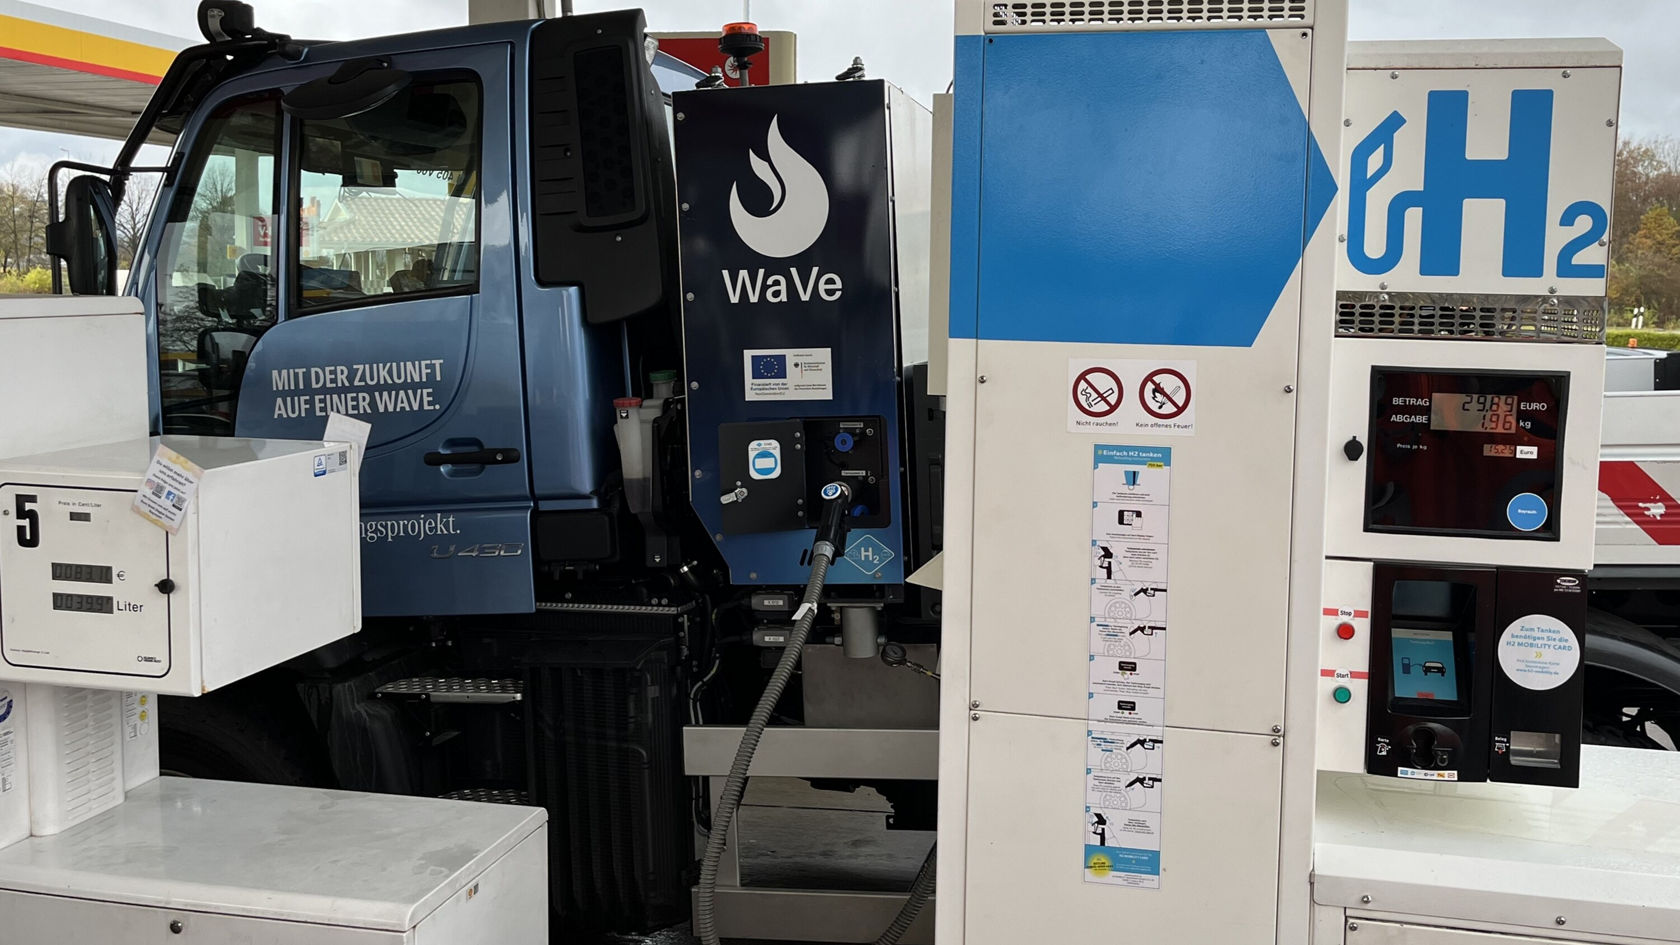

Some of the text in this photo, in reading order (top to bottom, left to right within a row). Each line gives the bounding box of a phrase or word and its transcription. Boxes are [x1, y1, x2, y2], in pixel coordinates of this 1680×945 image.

[1419, 89, 1608, 278] H2
[721, 266, 843, 303] WaVe
[271, 359, 443, 390] MIT DER ZUKUNFT
[273, 388, 440, 418] AUF EINER WAVE.
[1392, 394, 1547, 413] BETRAG 29,89 EURO
[1390, 414, 1531, 431] ABGABE 1,96 kg
[1103, 449, 1128, 457] Einfach
[15, 493, 40, 549] 5
[430, 543, 525, 560] U 430
[860, 546, 880, 564] H2
[117, 570, 126, 581] €
[117, 600, 144, 612] Liter
[1511, 634, 1545, 642] benötigen
